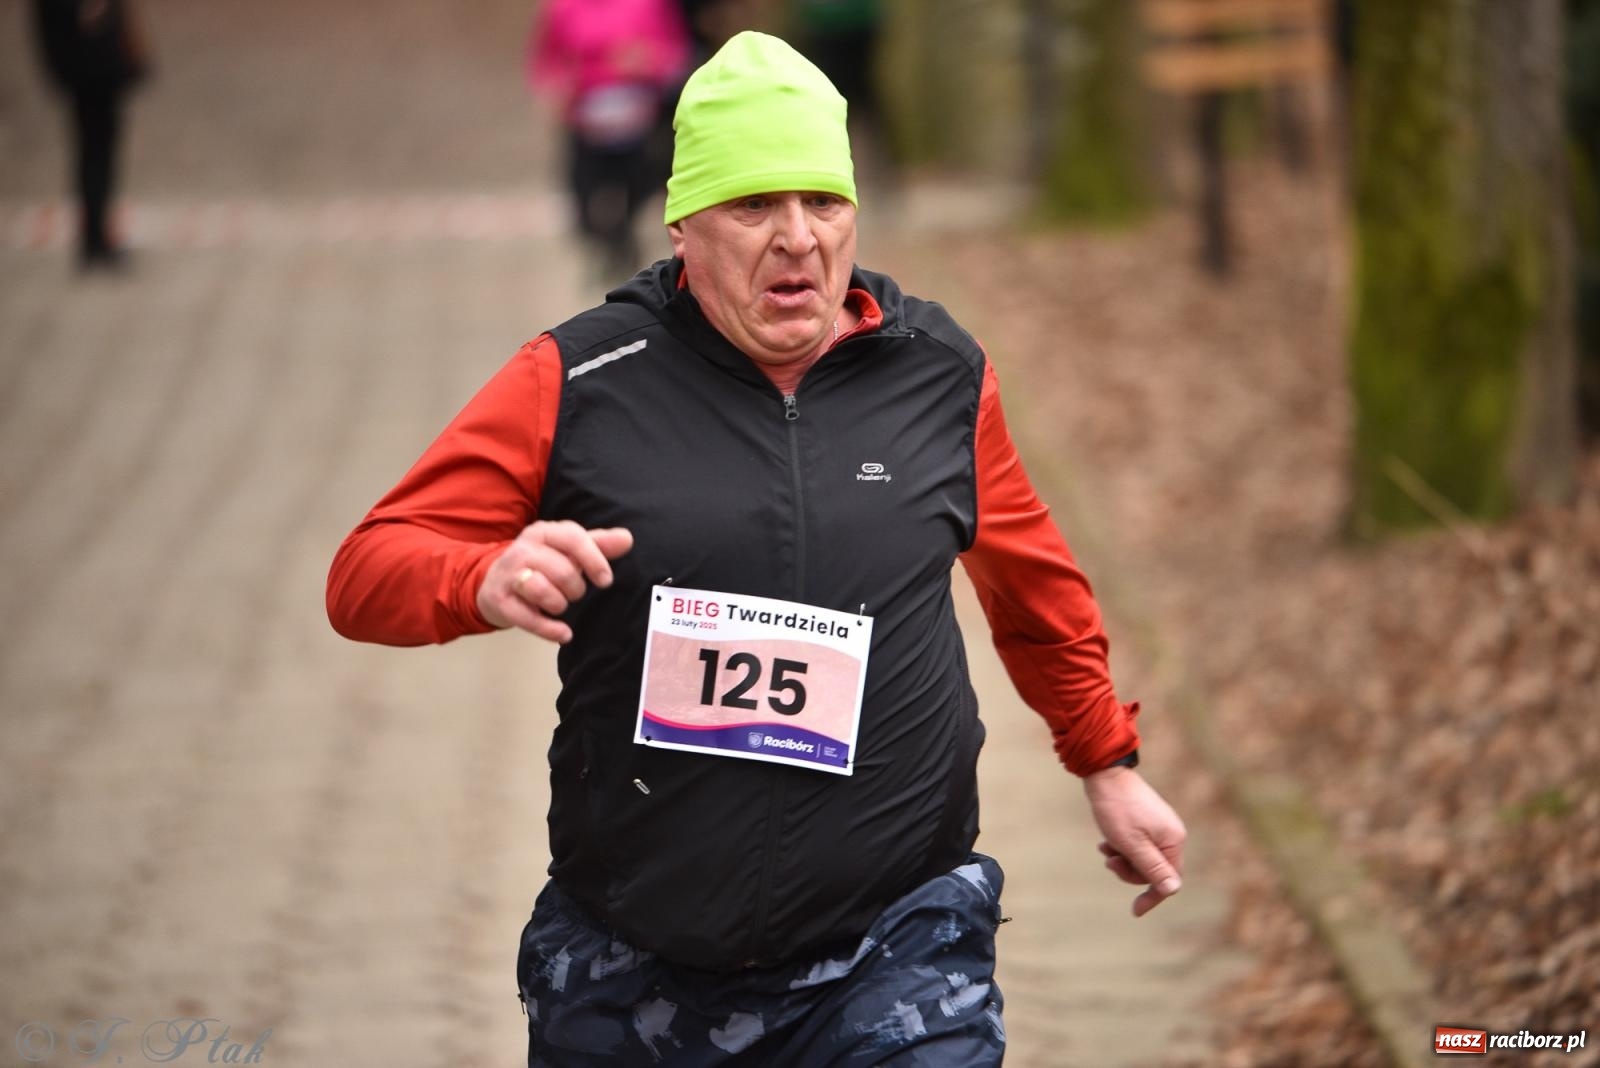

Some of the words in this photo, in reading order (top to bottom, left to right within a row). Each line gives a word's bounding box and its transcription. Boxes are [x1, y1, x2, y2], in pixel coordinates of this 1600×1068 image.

[672, 598, 720, 618] BIEG
[726, 604, 849, 639] Twardziela
[681, 619, 698, 630] luty
[698, 648, 809, 716] 125
[763, 735, 815, 754] Racibórz
